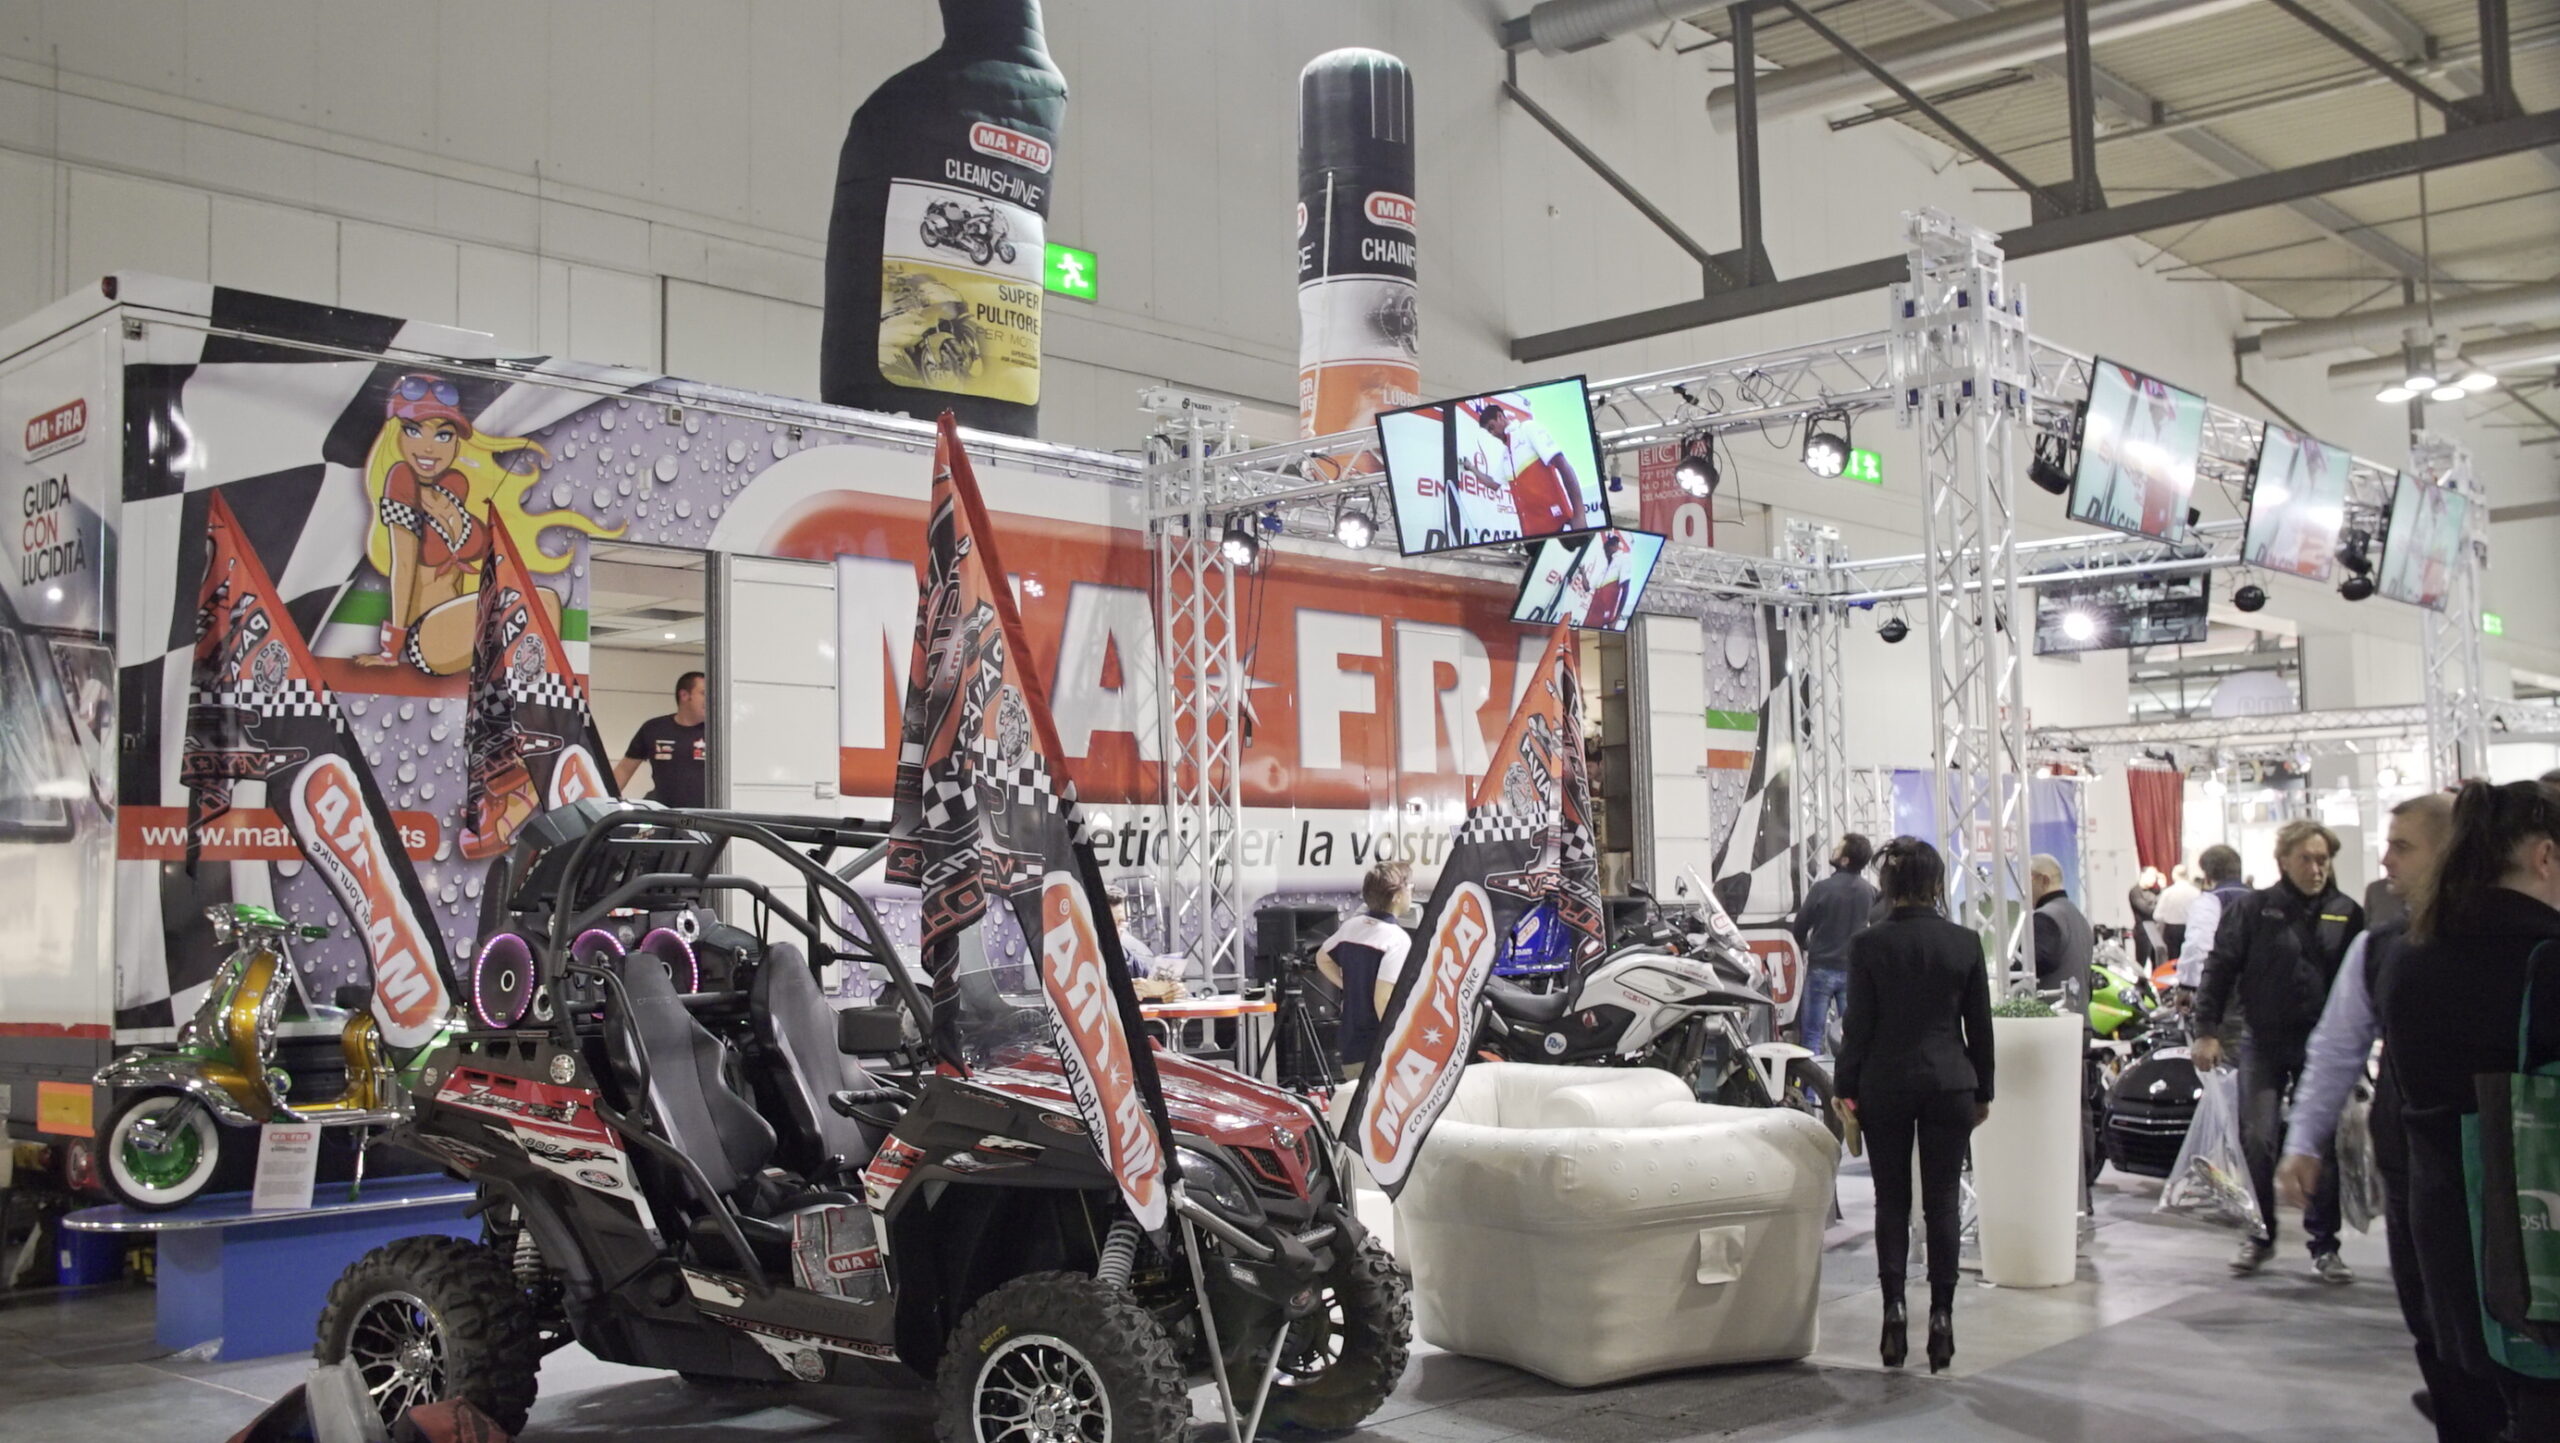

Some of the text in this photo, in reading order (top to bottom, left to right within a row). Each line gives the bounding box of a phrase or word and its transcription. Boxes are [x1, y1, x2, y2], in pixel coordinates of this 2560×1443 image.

[998, 284, 1040, 312] SUPER
[976, 303, 1040, 336] PULITORE
[23, 473, 72, 519] GUIDA
[22, 511, 59, 553] CON
[22, 527, 87, 588] LUCIDITÀ
[1298, 820, 1334, 866] la
[1460, 967, 1481, 1001] bike
[1456, 1034, 1468, 1061] for
[1408, 1059, 1459, 1134] cosmetics
